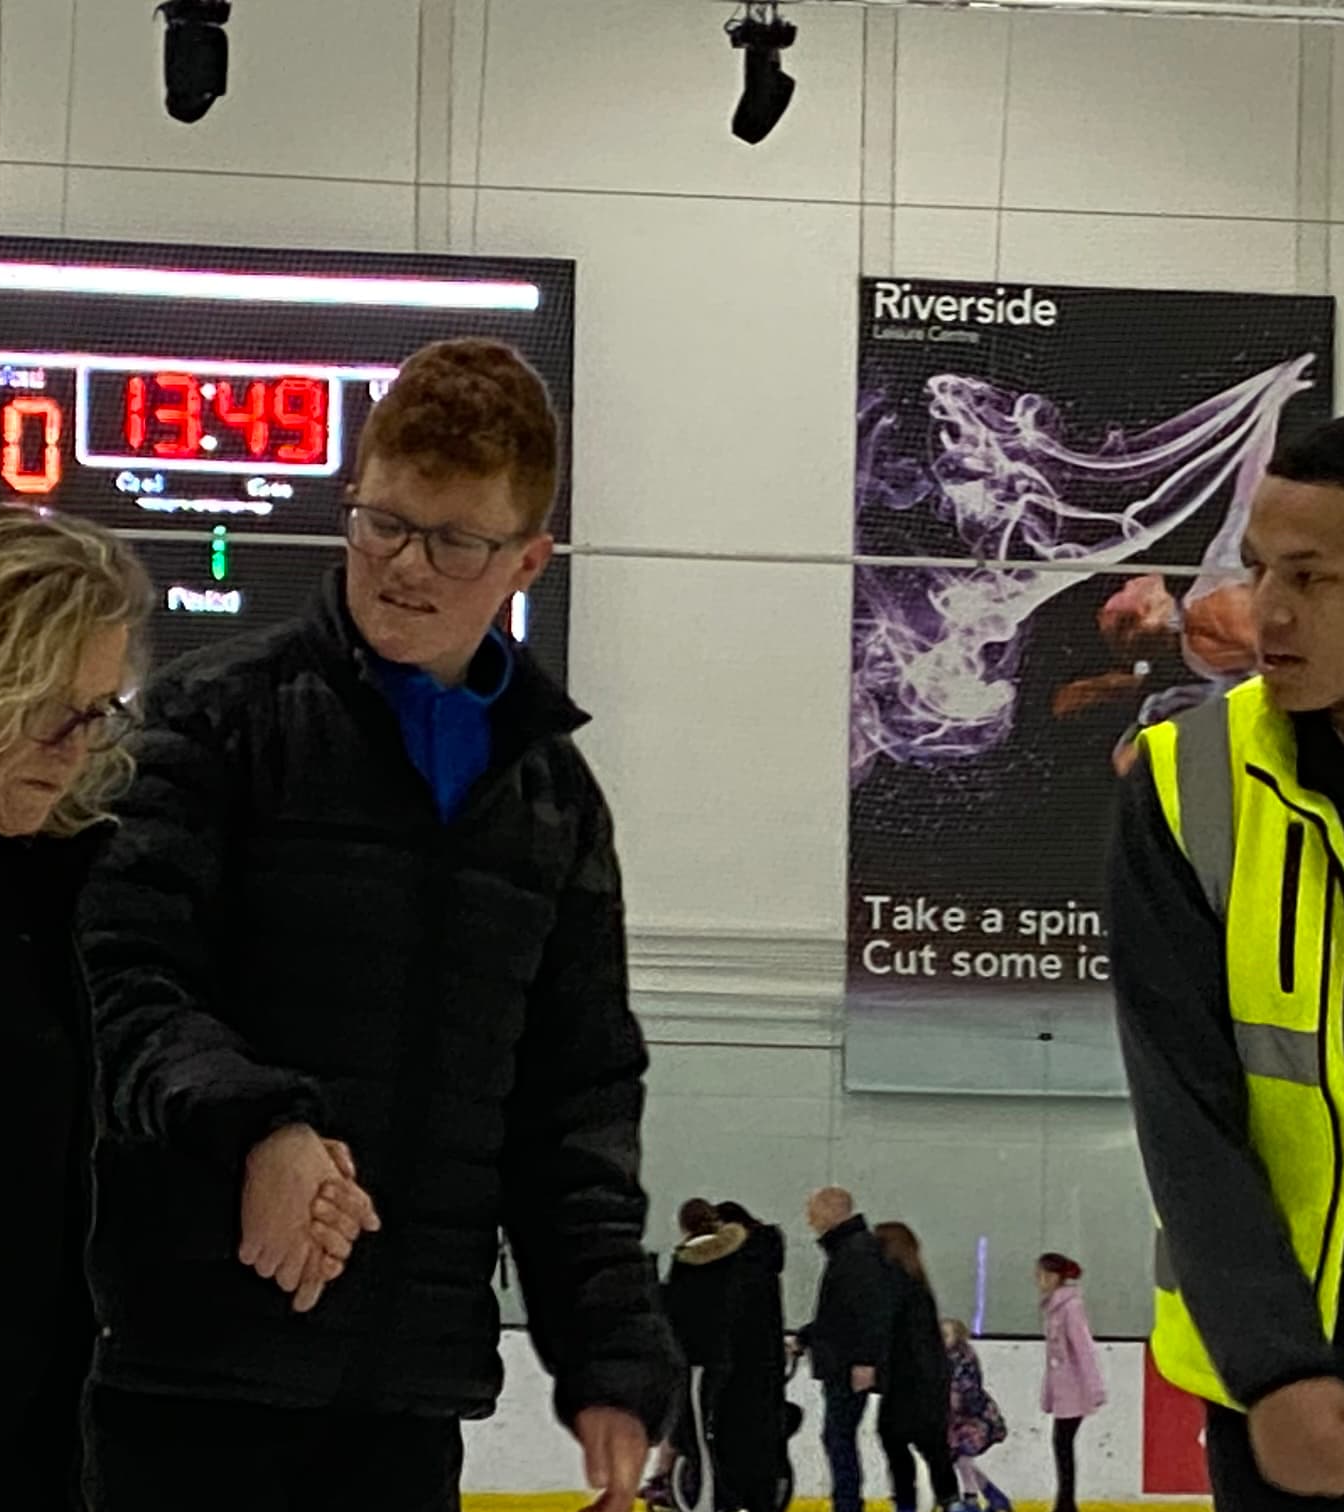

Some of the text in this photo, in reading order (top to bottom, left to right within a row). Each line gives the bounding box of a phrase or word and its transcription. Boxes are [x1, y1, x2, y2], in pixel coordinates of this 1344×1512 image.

[874, 281, 1057, 326] Riverside
[124, 370, 328, 464] 13:49
[863, 895, 966, 932] Take
[980, 907, 1004, 934] a
[862, 939, 937, 976] Cut
[951, 950, 1063, 979] some
